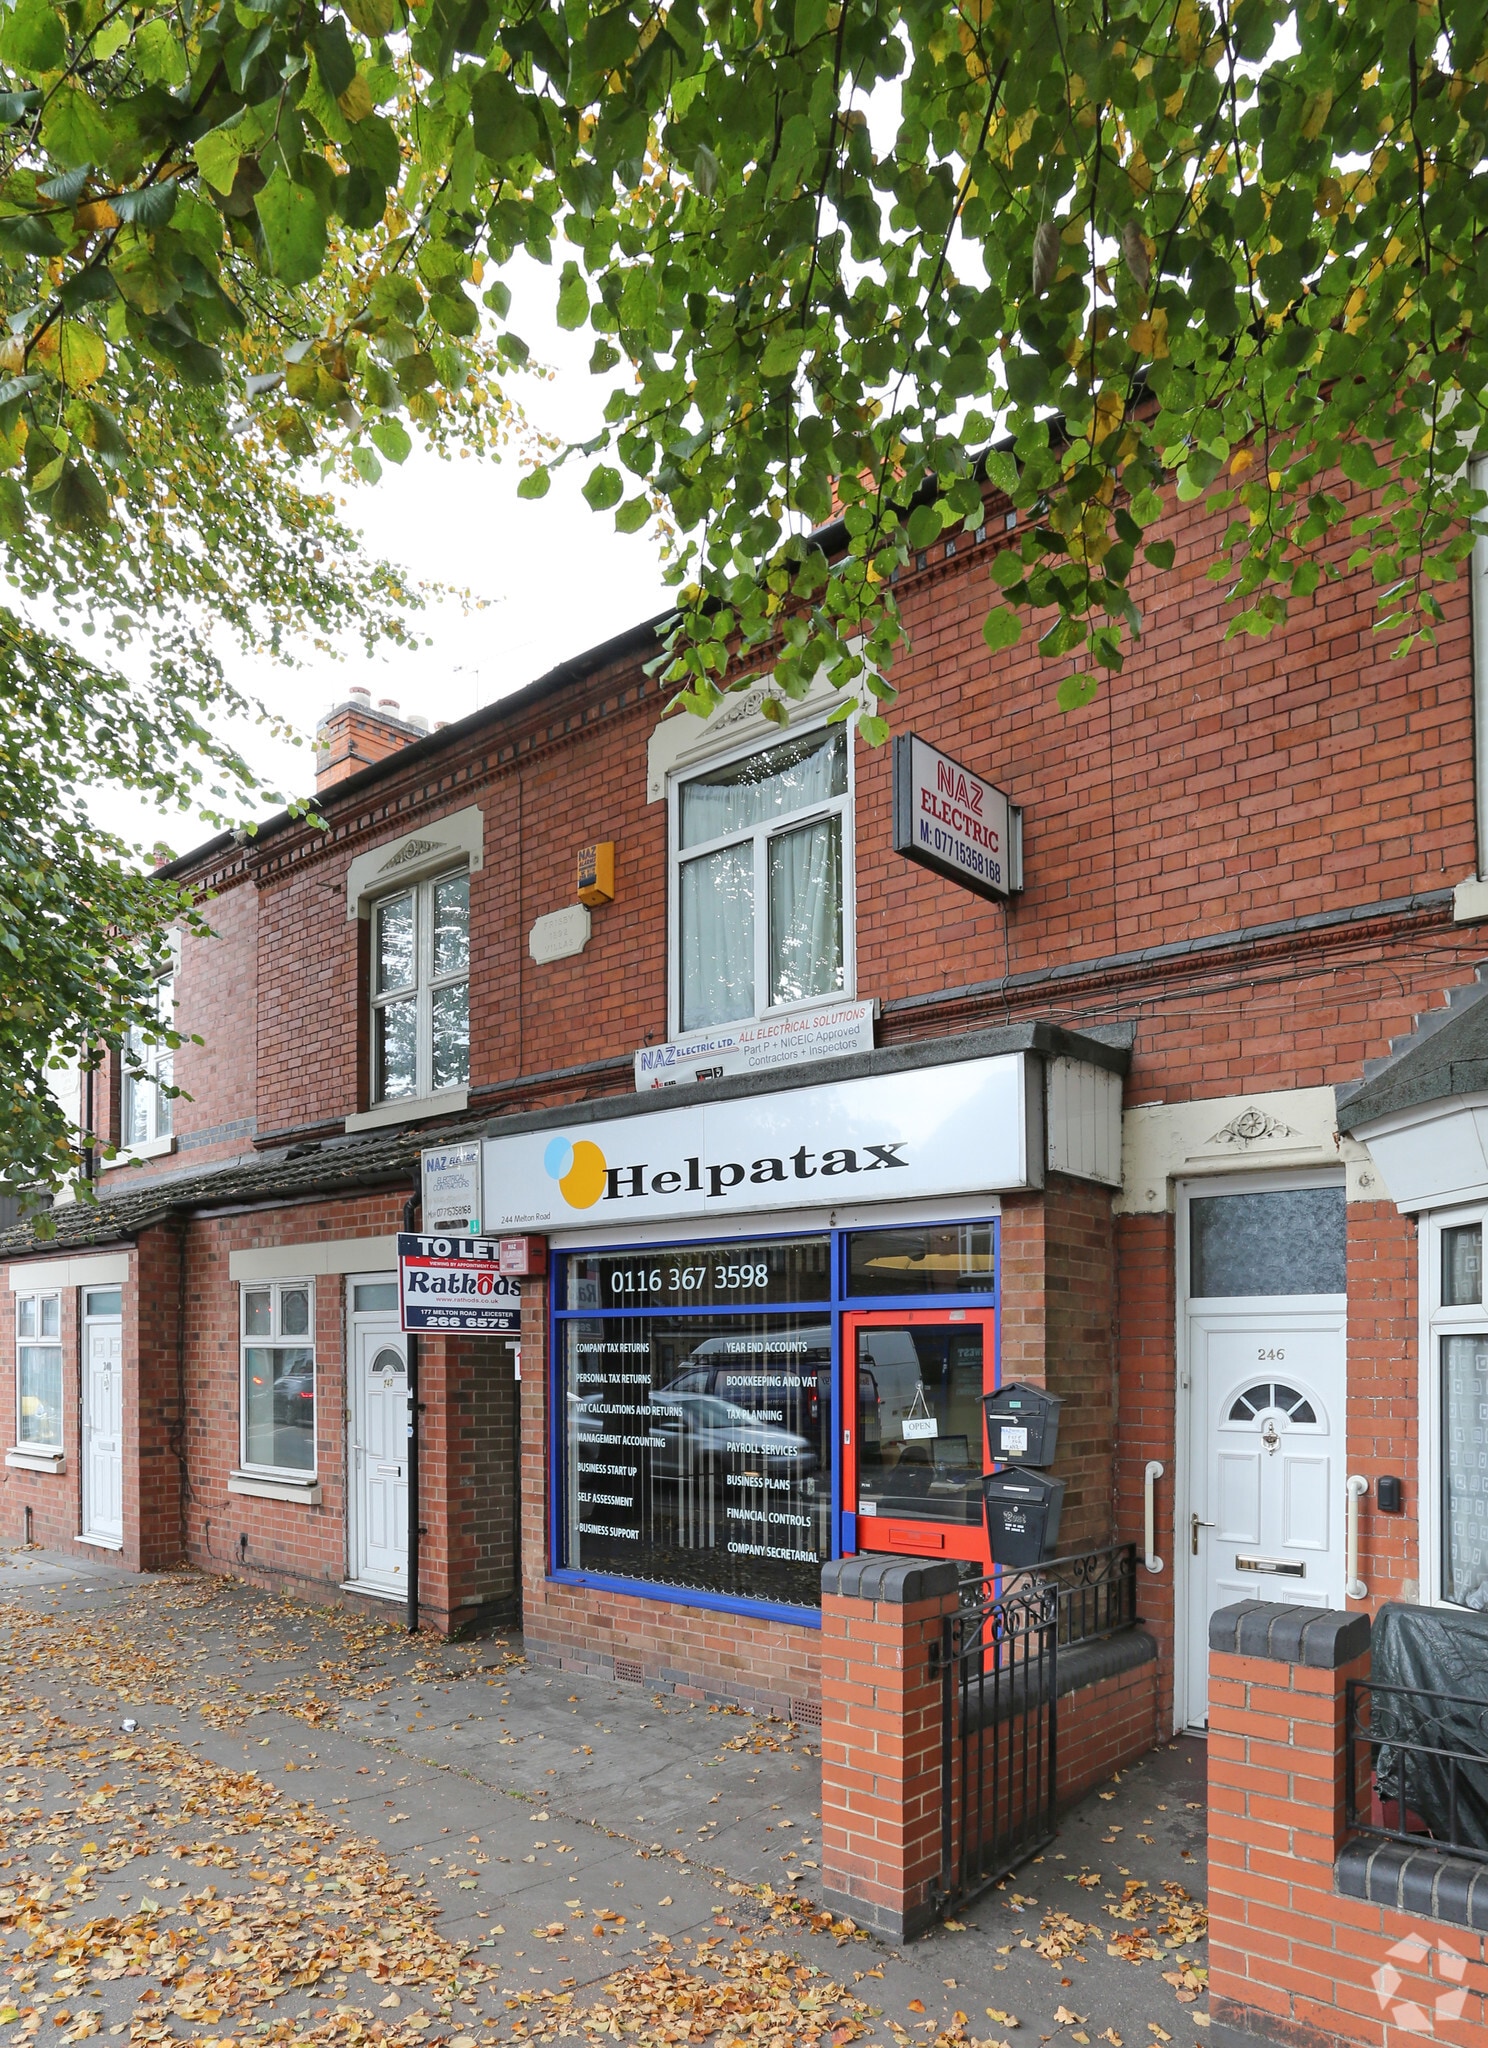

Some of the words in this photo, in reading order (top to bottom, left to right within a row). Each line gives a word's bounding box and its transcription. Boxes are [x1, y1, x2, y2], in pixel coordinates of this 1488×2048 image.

[937, 760, 984, 817] NAZ
[921, 787, 999, 853] ELECTRIC
[920, 819, 932, 845] M:
[935, 828, 1000, 884] 07715358168
[739, 1031, 755, 1043] ALL
[757, 1019, 810, 1040] ELECTRICAL
[813, 1007, 866, 1028] SOLUTIONS
[743, 1043, 761, 1056] Part
[763, 1042, 770, 1052] P
[780, 1032, 814, 1048] NICEIC
[816, 1024, 860, 1042] Approved
[641, 1046, 676, 1071] NAZ
[677, 1042, 715, 1057] ELECTRIC
[748, 1051, 798, 1067] Contractors
[809, 1039, 858, 1056] Inspectors
[427, 1157, 447, 1172] NAZ
[602, 1142, 909, 1200] Helpatax
[501, 1215, 513, 1225] 244
[514, 1213, 535, 1223] Melton
[536, 1211, 551, 1221] Road
[417, 1238, 452, 1257] TO
[459, 1240, 500, 1260] LET
[408, 1271, 521, 1297] Rathods
[611, 1269, 662, 1293] 0116
[668, 1267, 706, 1291] 367
[714, 1264, 769, 1290] 3598
[426, 1316, 460, 1327] 266
[465, 1317, 510, 1328] 6575
[576, 1343, 605, 1353] COMPANY
[607, 1343, 619, 1353] TAX
[620, 1343, 649, 1353] RETURNS
[726, 1342, 746, 1353] YEAR
[747, 1342, 763, 1353] END
[764, 1341, 808, 1353] ACCOUNTS
[1258, 1348, 1285, 1361] 246
[576, 1373, 607, 1383] PERSONAL
[608, 1374, 620, 1384] TAX
[621, 1374, 651, 1384] RETURNS
[726, 1375, 780, 1387] BOOKKEEPING
[782, 1376, 800, 1387] AND
[801, 1376, 817, 1388] VAT
[576, 1403, 587, 1413] VAT
[588, 1403, 635, 1415] CALCULATIONS
[636, 1405, 651, 1415] AND
[652, 1406, 683, 1417] RETURNS
[726, 1409, 741, 1419] TAX
[742, 1409, 783, 1421] PLANNING
[909, 1422, 931, 1431] OPEN
[577, 1433, 621, 1445] MANAGEMENT
[622, 1435, 666, 1448] ACCOUNTING
[726, 1441, 760, 1454] PAYROLL
[761, 1444, 798, 1457] SERVICES
[577, 1462, 607, 1474] BUSINESS
[607, 1465, 627, 1476] START
[627, 1466, 637, 1477] UP
[726, 1474, 763, 1488] BUSINESS
[764, 1478, 790, 1490] PLANS
[577, 1491, 592, 1502] SELF
[592, 1494, 633, 1507] ASSESSMENT
[726, 1507, 767, 1522] FINANCIAL
[768, 1512, 811, 1527] CONTROLS
[579, 1522, 609, 1536] BUSINESS
[609, 1526, 639, 1540] SUPPORT
[727, 1542, 766, 1556] COMPANY
[766, 1546, 819, 1563] SECRETARIAL
